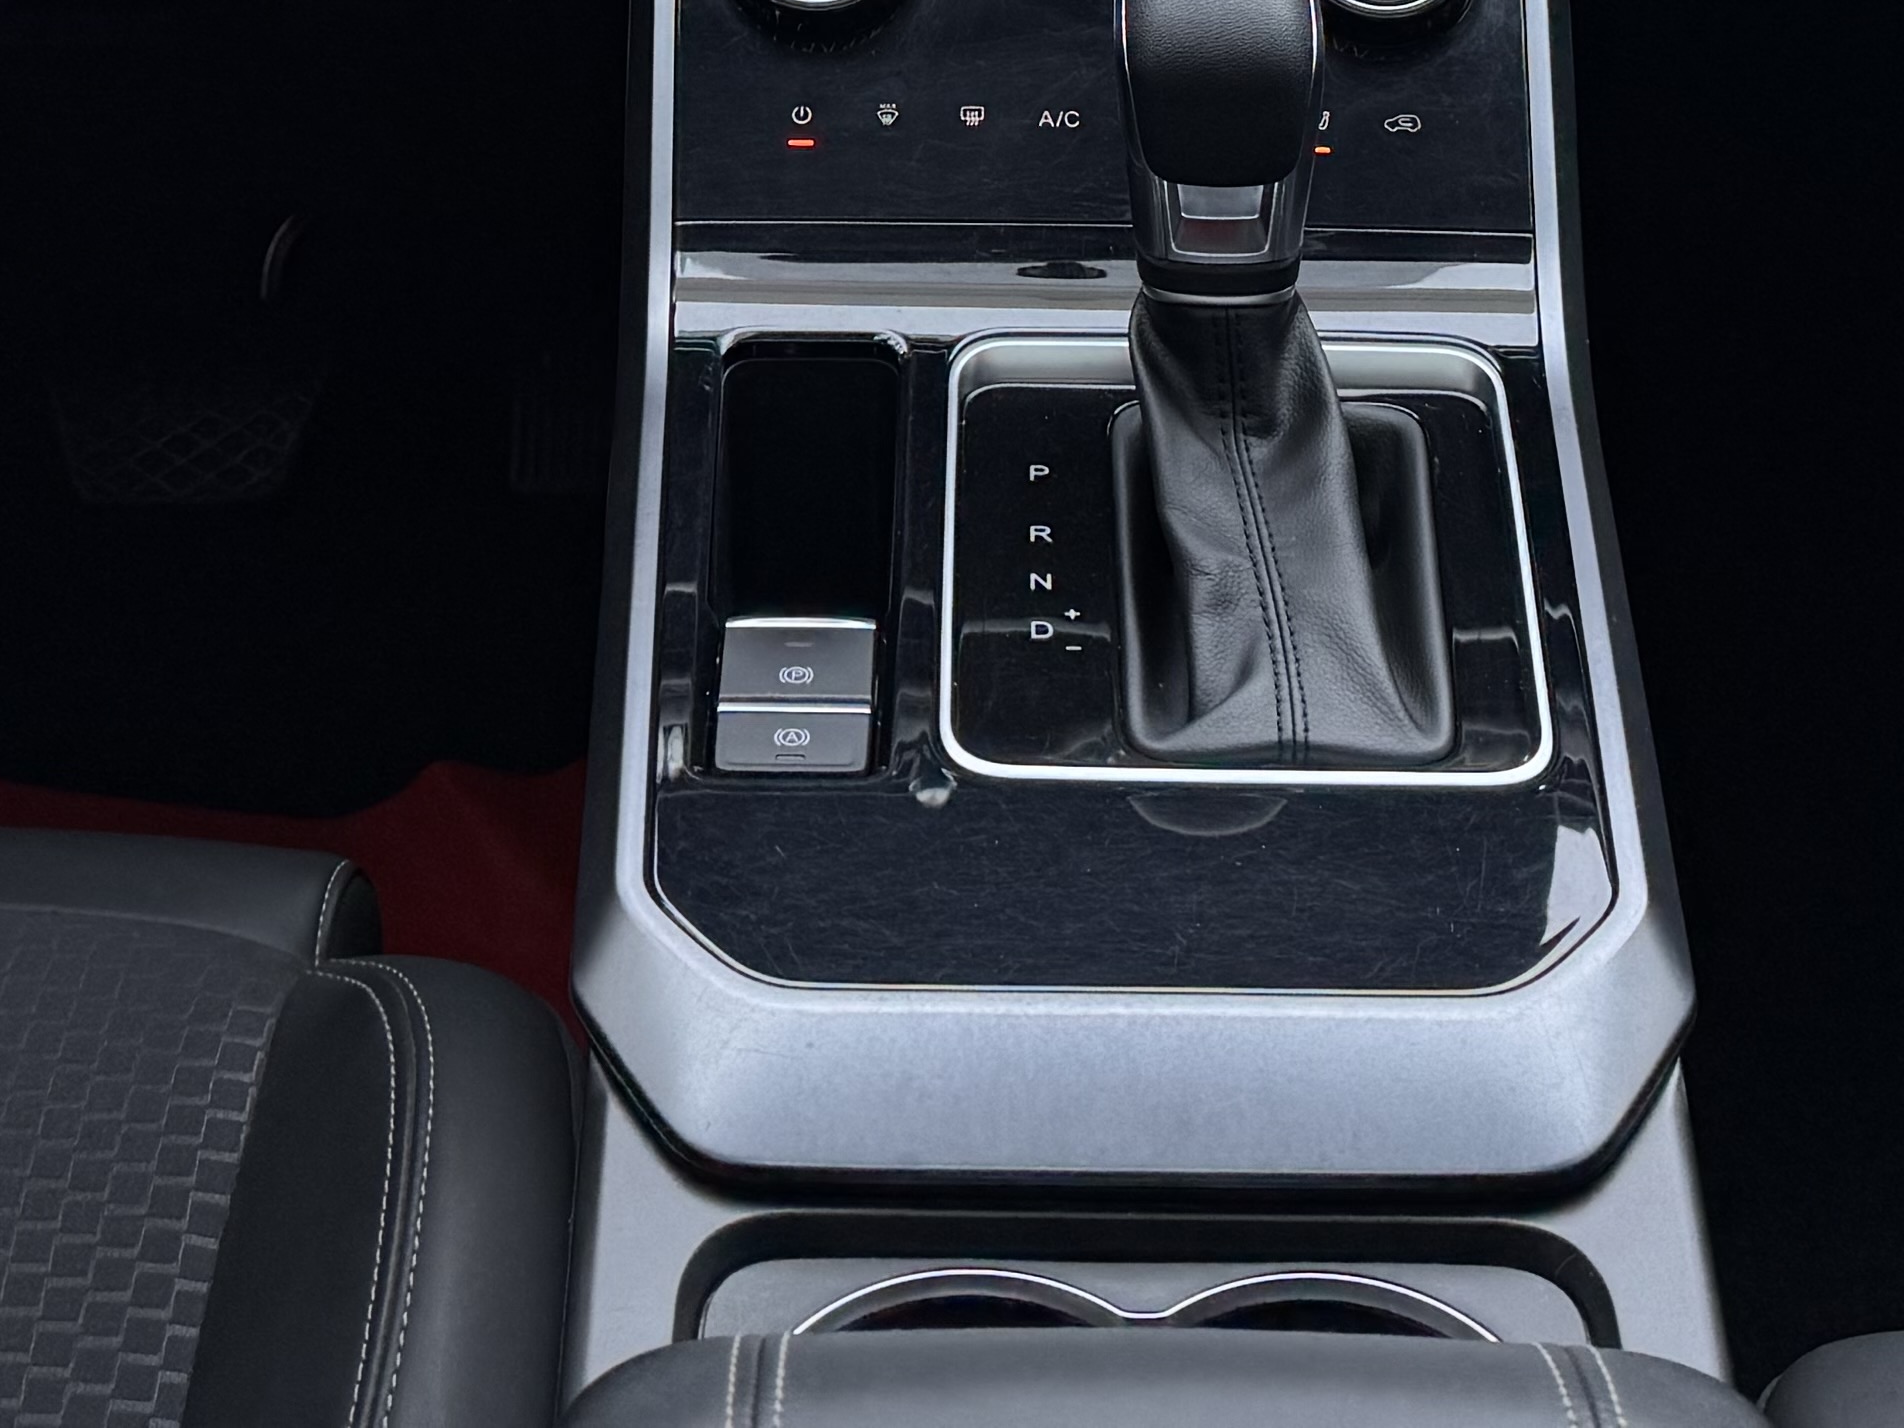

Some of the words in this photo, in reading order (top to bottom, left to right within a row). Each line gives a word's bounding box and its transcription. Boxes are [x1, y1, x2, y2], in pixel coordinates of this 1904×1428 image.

[1038, 110, 1080, 128] A/C
[1029, 464, 1050, 482] P
[1029, 525, 1053, 543] R
[1029, 573, 1053, 591] N
[1030, 620, 1054, 640] D
